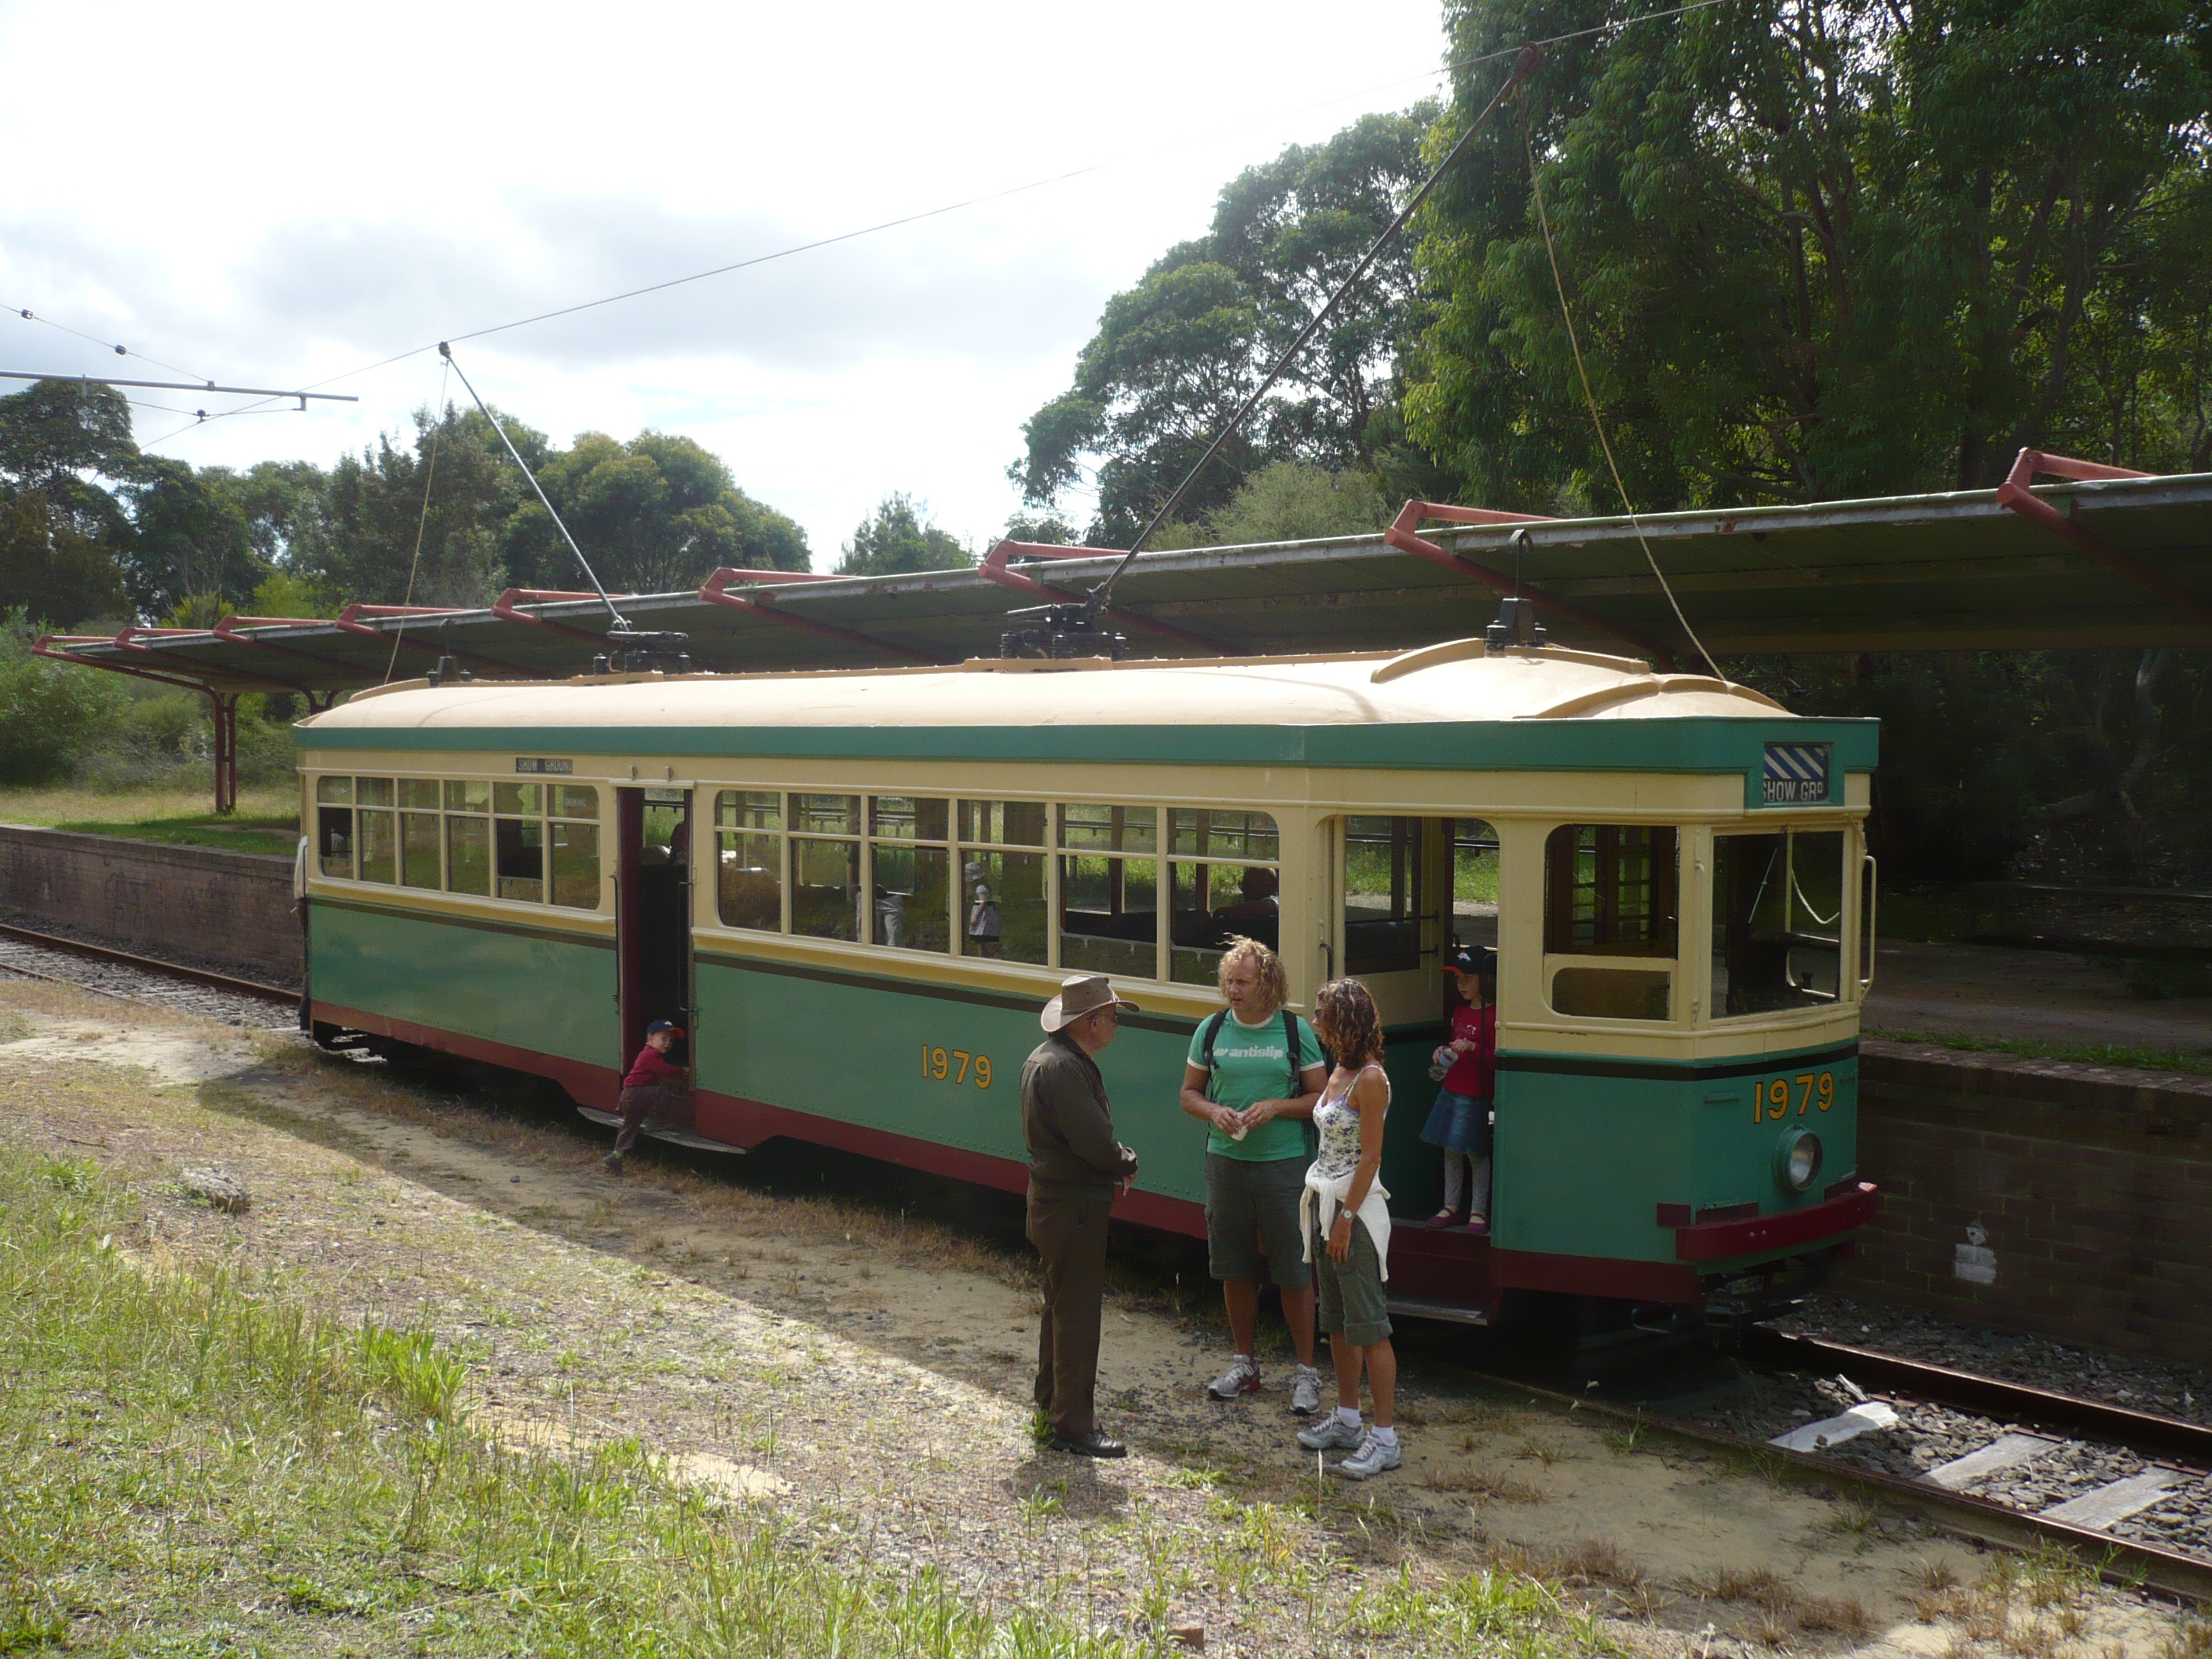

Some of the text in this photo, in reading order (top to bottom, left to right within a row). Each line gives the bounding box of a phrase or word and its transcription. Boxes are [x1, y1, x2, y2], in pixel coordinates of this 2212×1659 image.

[518, 759, 573, 771] SHOW GROUND
[922, 1044, 991, 1089] 1979
[1229, 1046, 1284, 1060] antislip
[1753, 1071, 1834, 1124] 1979
